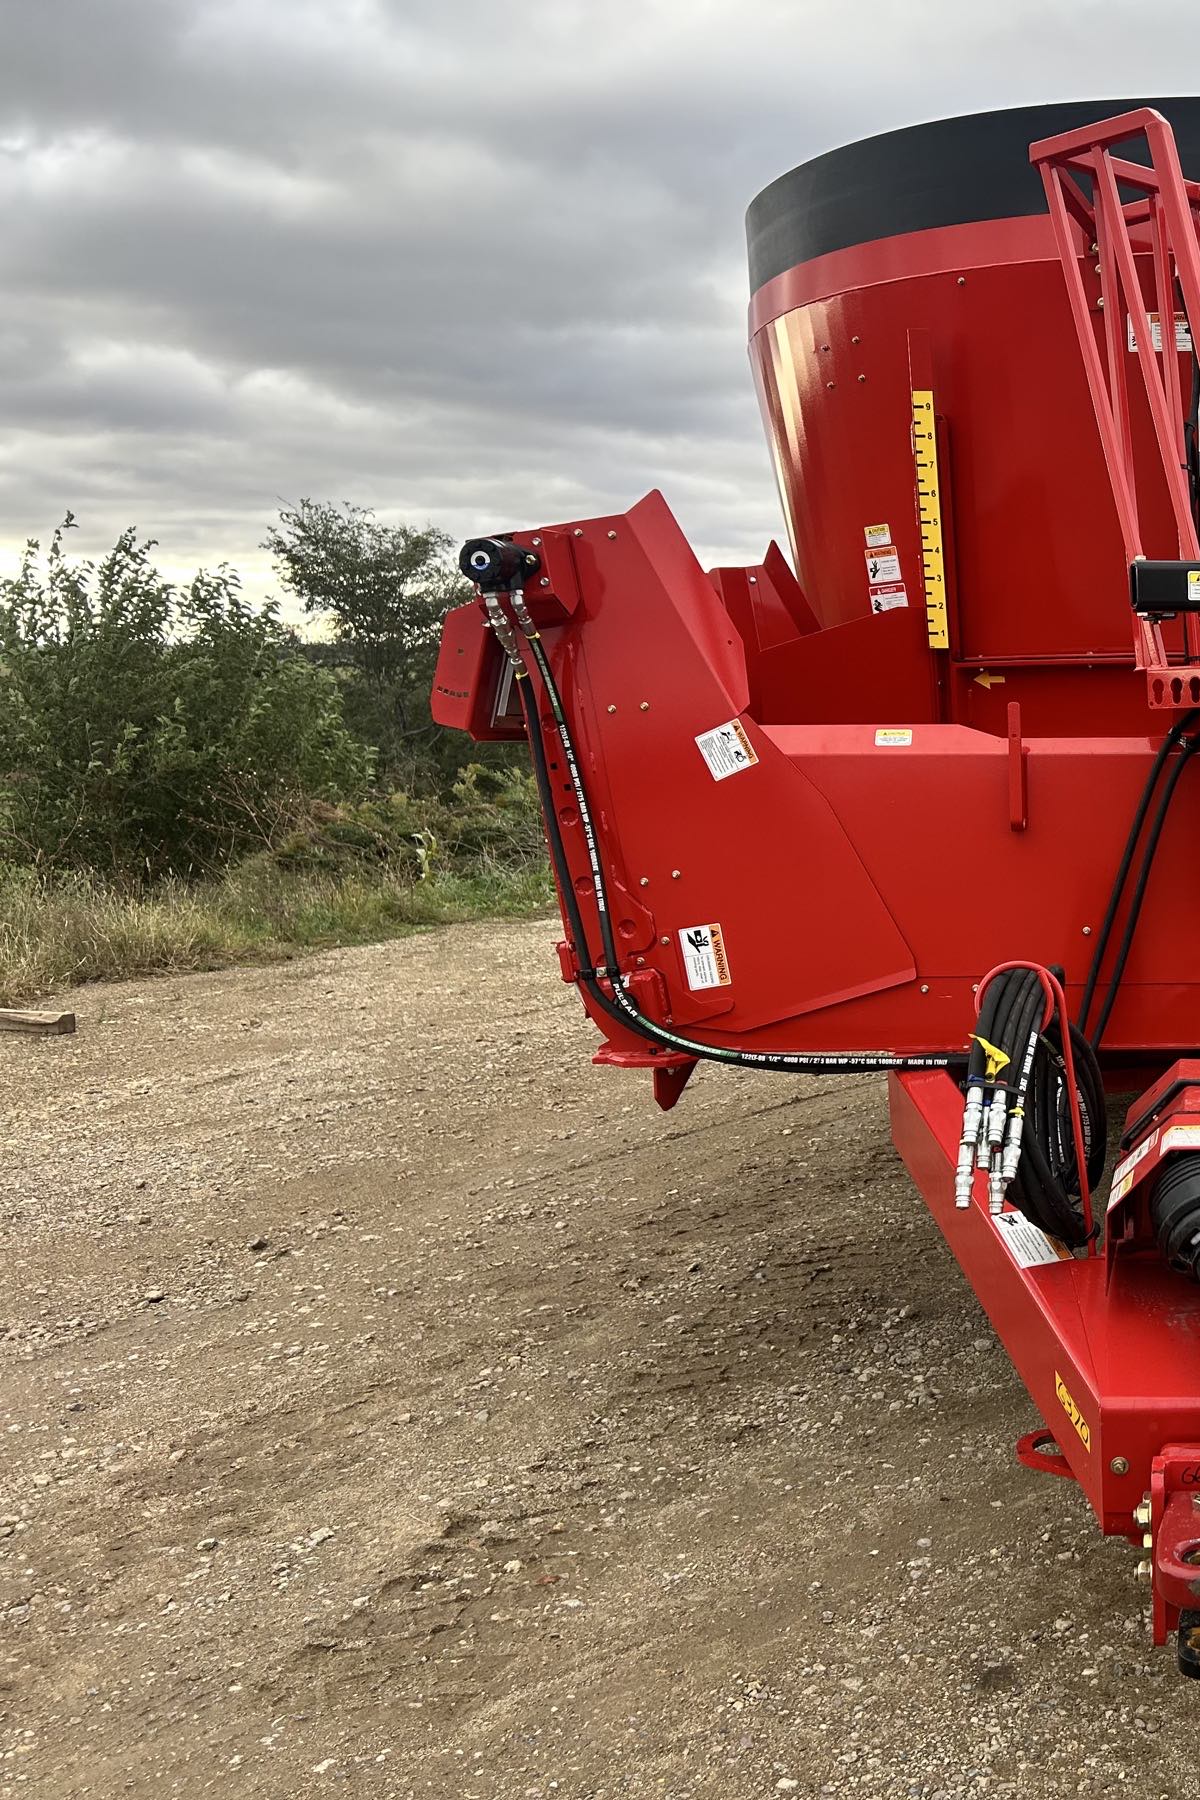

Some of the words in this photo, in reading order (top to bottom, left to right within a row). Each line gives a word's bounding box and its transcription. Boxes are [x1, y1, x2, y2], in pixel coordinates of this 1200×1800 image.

[925, 402, 931, 411] 9
[927, 432, 933, 440] 8
[929, 461, 934, 469] 7
[931, 489, 937, 498] 6
[933, 518, 938, 526] 5
[937, 574, 942, 582] 3
[938, 602, 944, 610] 2
[713, 939, 728, 981] WARNING
[612, 983, 638, 1017] PULSAR
[1022, 1054, 1033, 1074] MADE
